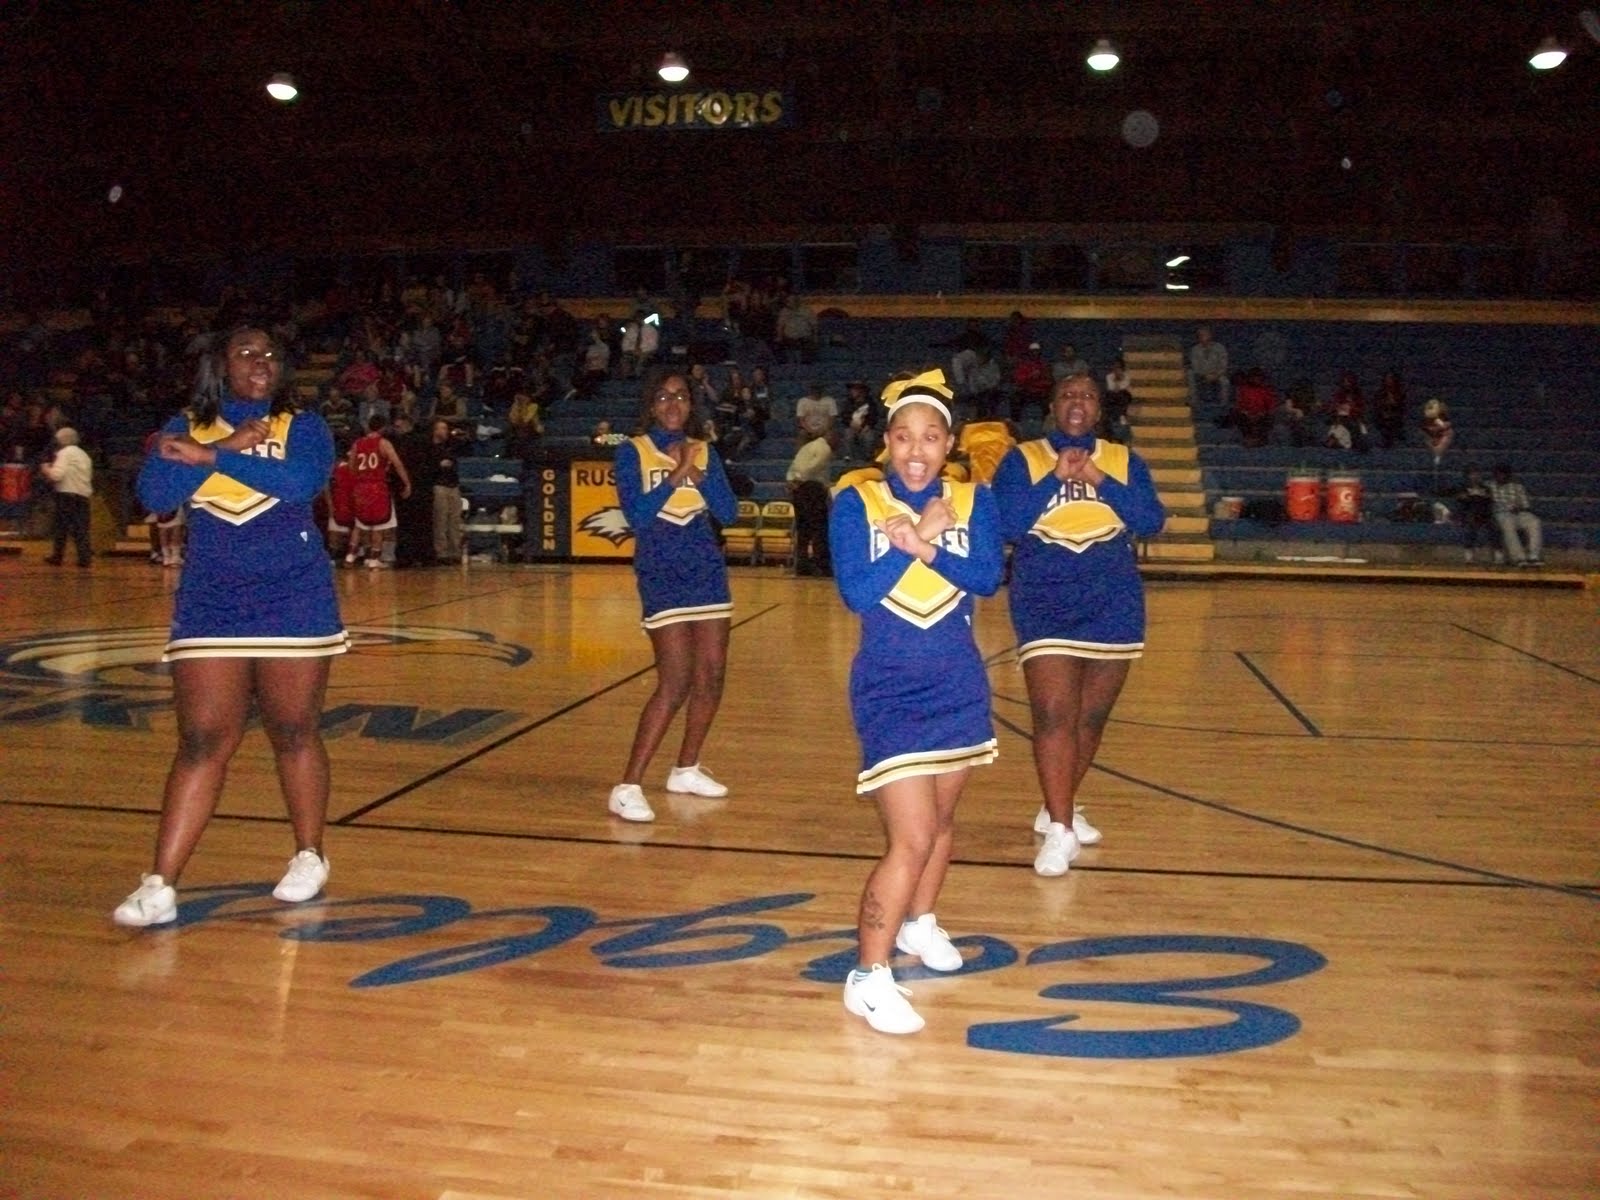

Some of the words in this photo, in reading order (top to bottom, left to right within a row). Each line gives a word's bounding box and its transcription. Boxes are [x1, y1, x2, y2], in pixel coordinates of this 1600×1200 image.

[608, 91, 783, 128] VISITORS
[356, 452, 379, 471] 20
[542, 468, 556, 550] GOLDEN
